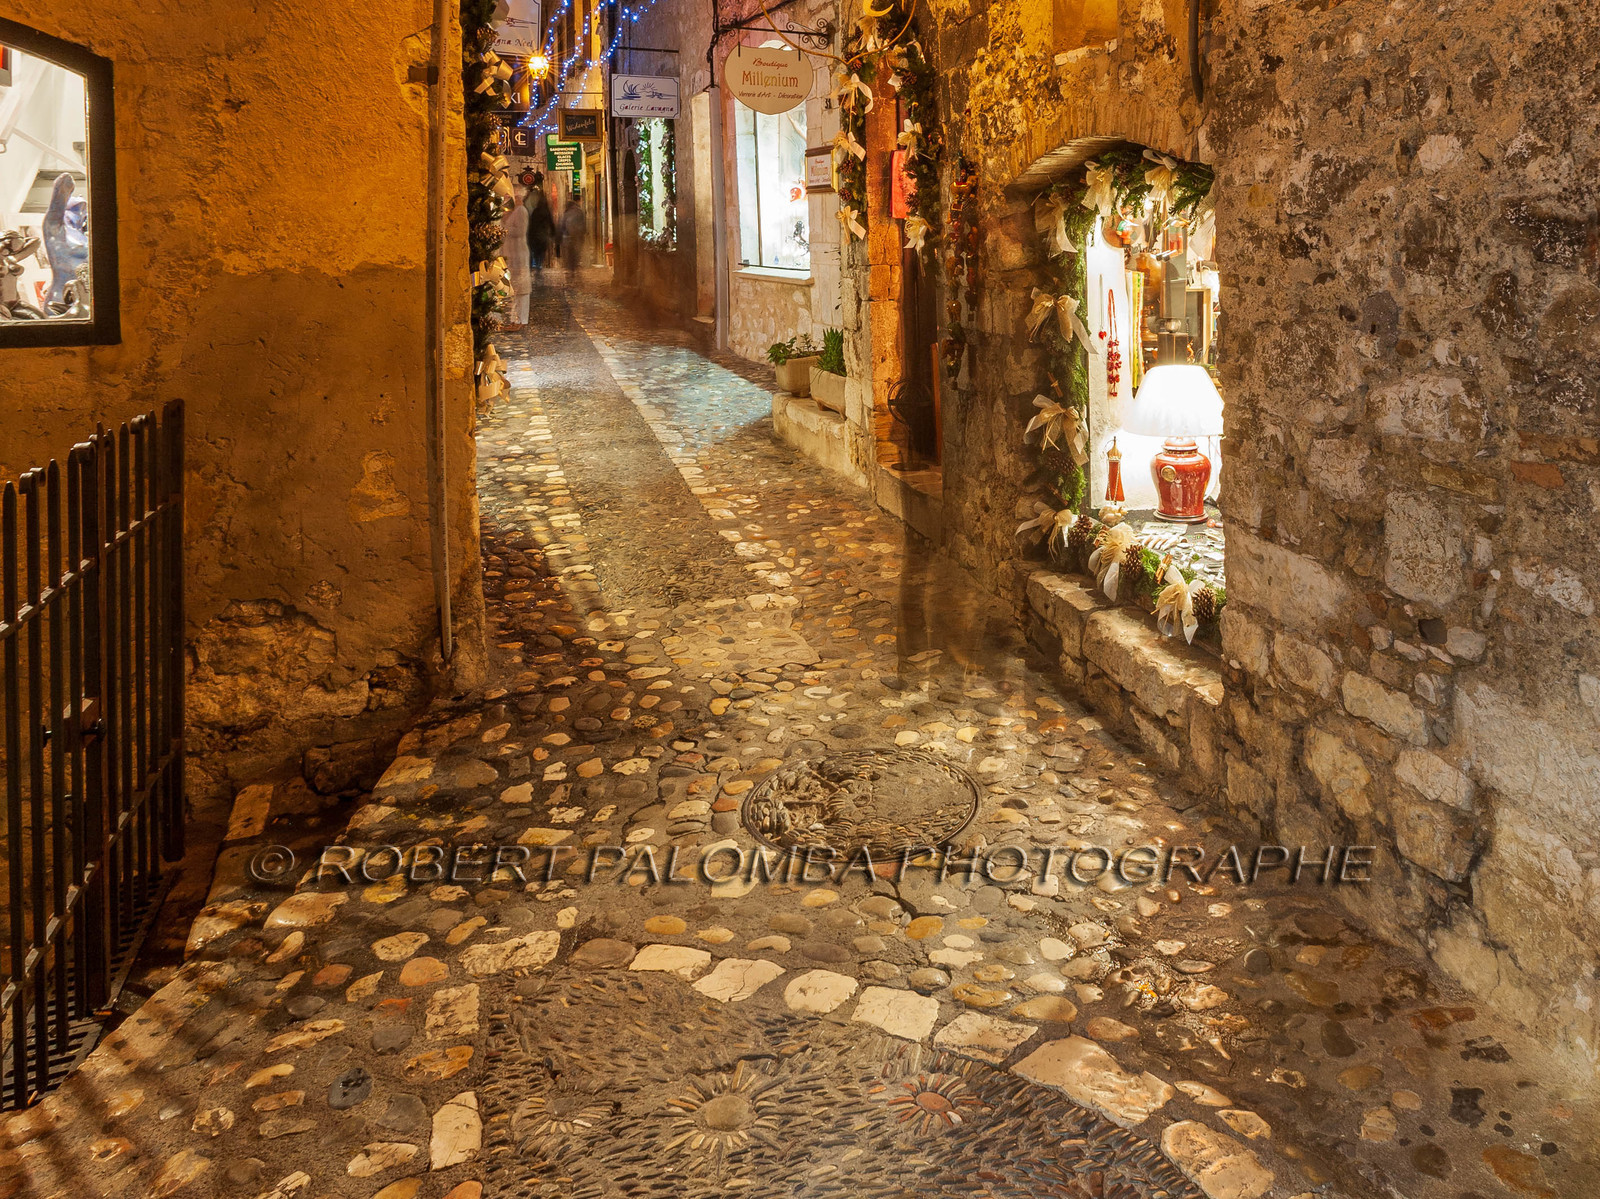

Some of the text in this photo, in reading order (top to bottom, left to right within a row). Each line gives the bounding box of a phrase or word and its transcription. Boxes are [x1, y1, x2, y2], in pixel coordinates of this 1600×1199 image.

[752, 57, 790, 70] Boutique
[741, 70, 799, 88] Millenium
[619, 103, 675, 114] Galerie Lavagna
